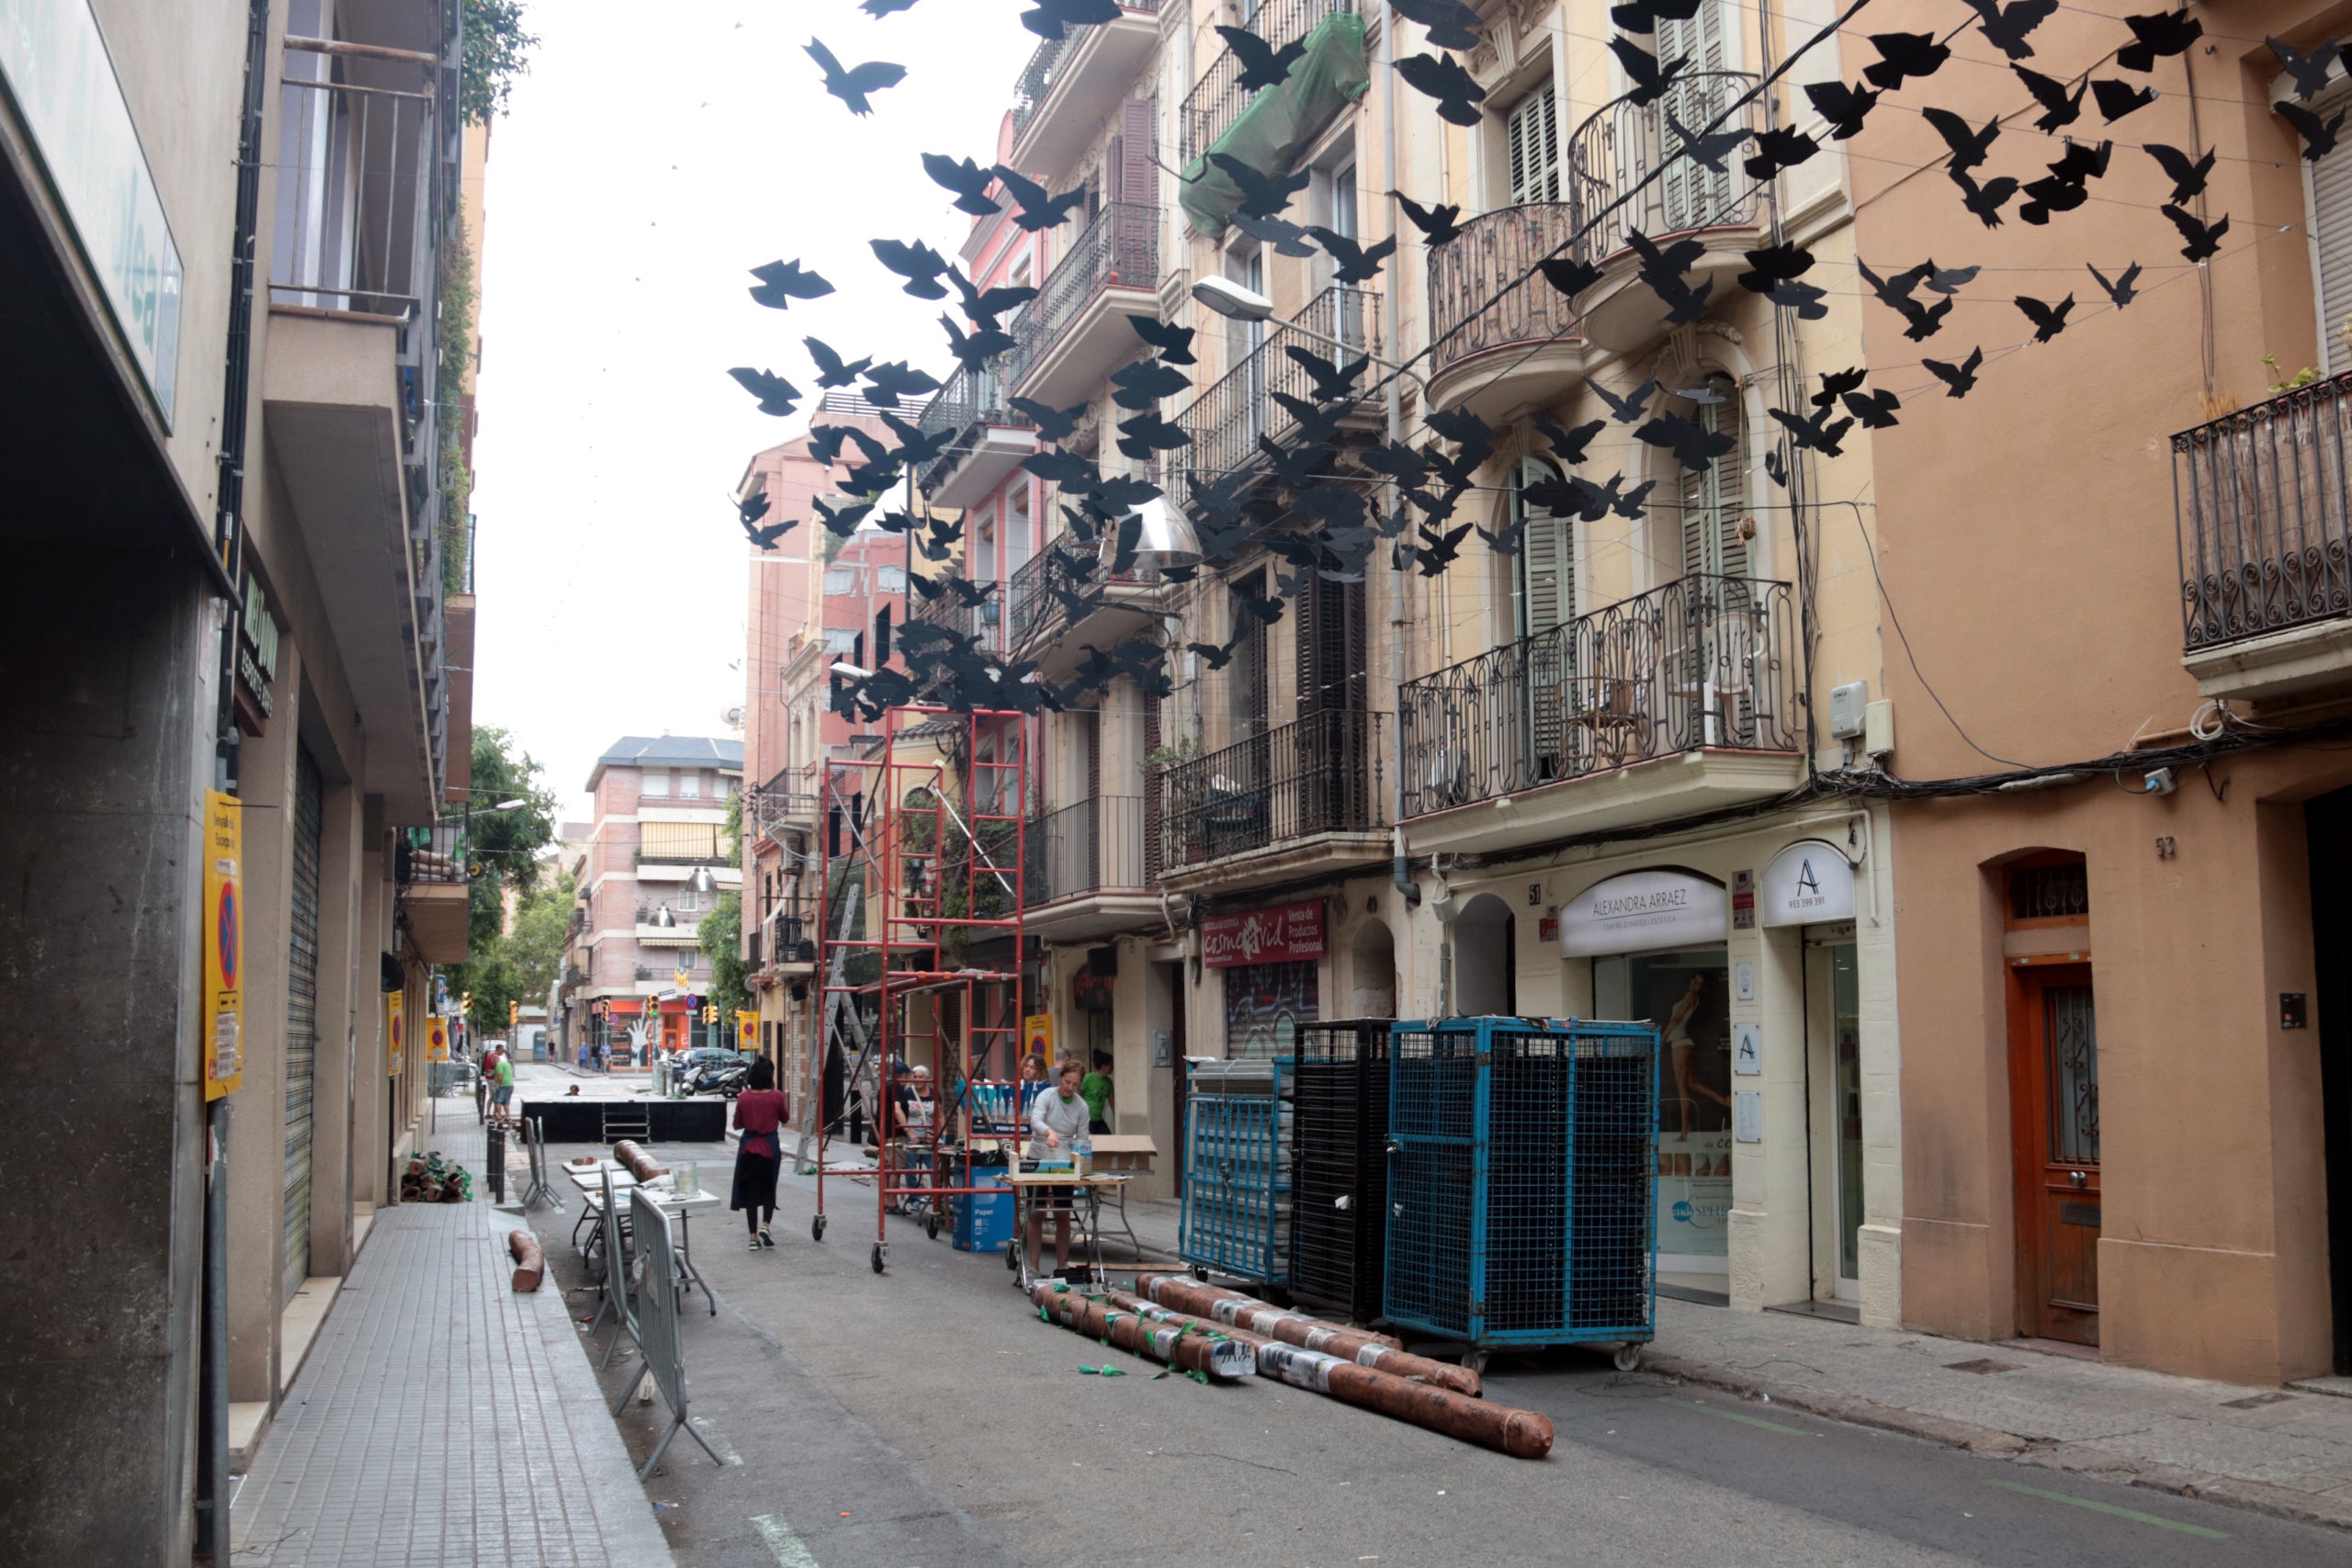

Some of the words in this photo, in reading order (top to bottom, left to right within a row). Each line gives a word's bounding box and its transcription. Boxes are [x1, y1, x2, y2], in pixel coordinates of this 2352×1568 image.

[2155, 836, 2176, 857] 53
[1796, 858, 1820, 897] A
[1529, 884, 1541, 905] 51
[1592, 895, 1646, 917] ALEXANDRA
[1648, 888, 1687, 908] ARRAEZ
[1789, 899, 1800, 909] 933
[1801, 897, 1813, 908] 399
[1815, 897, 1825, 906] 391
[1288, 908, 1305, 922] Venta
[1305, 907, 1314, 919] de
[1288, 925, 1317, 937] Productos
[1602, 921, 1623, 931] CENTRE
[1289, 938, 1323, 953] Profesional
[1739, 1033, 1755, 1059] A
